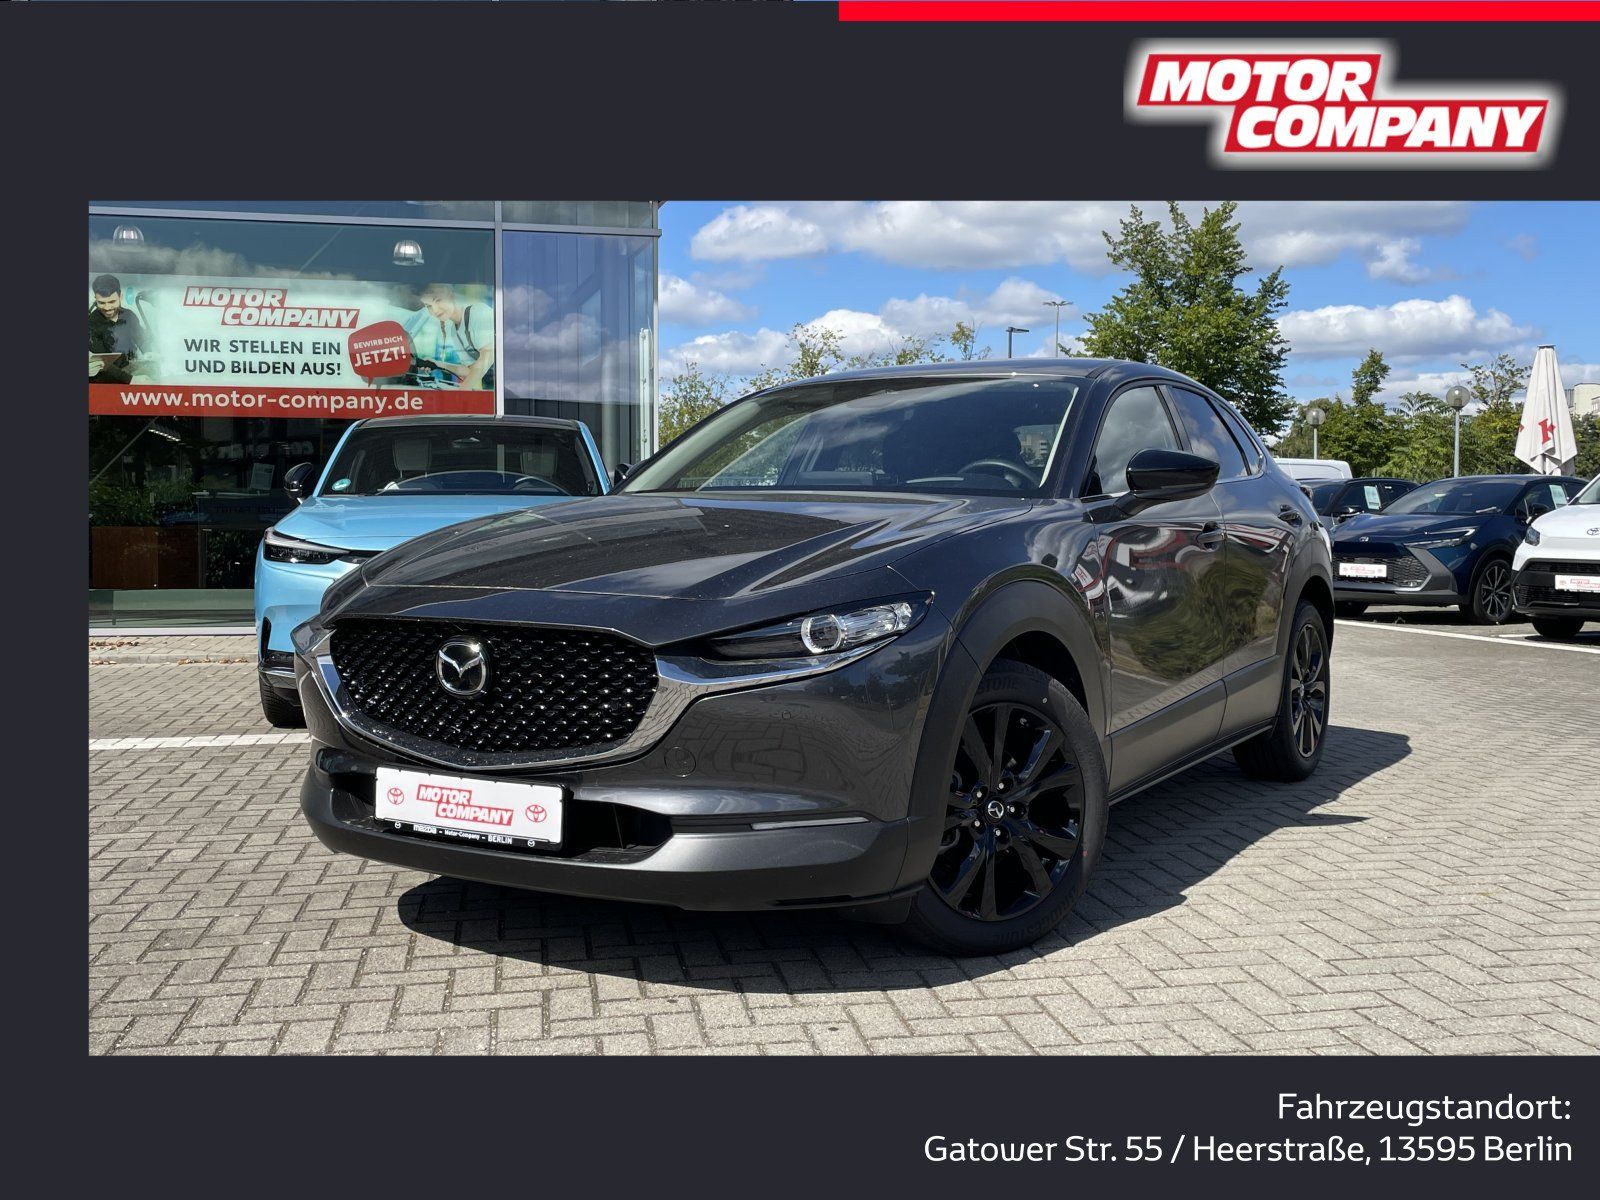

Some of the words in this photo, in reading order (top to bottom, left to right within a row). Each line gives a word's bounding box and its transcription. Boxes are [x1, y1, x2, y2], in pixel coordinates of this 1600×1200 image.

[186, 288, 282, 307] MOTOR
[224, 307, 358, 327] COMPANY
[184, 338, 221, 353] WIR
[229, 339, 303, 354] STELLEN
[312, 341, 341, 355] EIN
[353, 338, 383, 349] BEWIRB
[384, 335, 403, 345] DICH
[354, 346, 407, 367] JETZT!
[185, 360, 226, 373] UND
[231, 360, 295, 375] BILDEN
[300, 362, 341, 375] AUS!
[120, 390, 424, 414] www.motor-company.de
[418, 786, 471, 805] MOTOR
[437, 804, 513, 825] COMPANY
[487, 834, 513, 844] BERLIN
